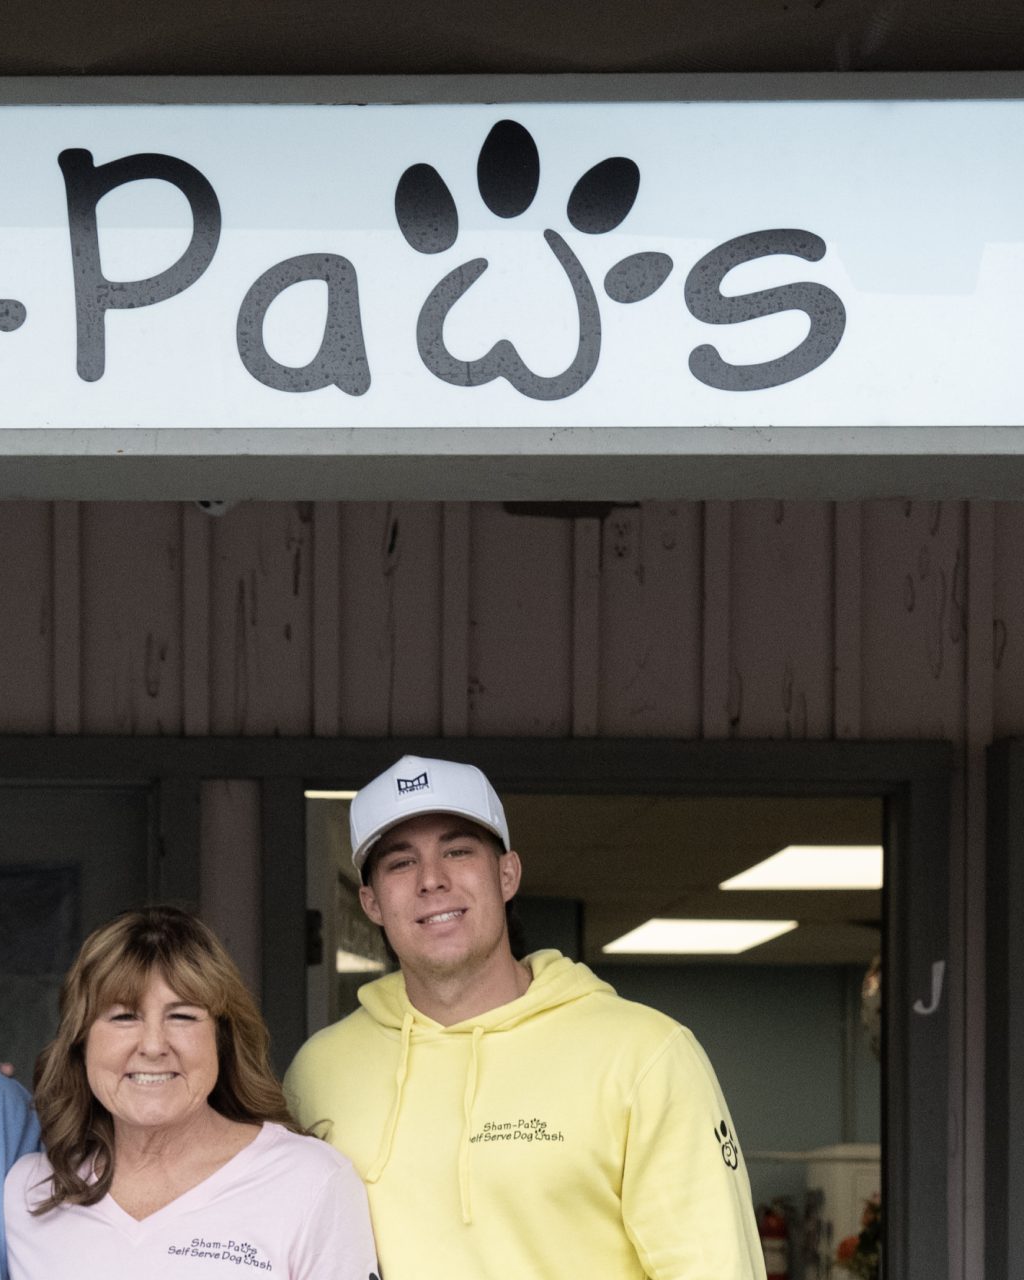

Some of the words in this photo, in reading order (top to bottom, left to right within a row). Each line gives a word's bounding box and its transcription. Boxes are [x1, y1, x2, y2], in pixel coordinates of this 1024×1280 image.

[483, 1118, 548, 1132] Sham-Paws
[484, 1132, 512, 1142] Serve
[513, 1130, 533, 1142] Dog
[535, 1128, 565, 1142] Wash
[191, 1238, 258, 1255] Sham-Paws
[167, 1245, 190, 1256] Self
[190, 1248, 221, 1260] Serve
[221, 1251, 242, 1264] Dog
[243, 1253, 273, 1271] Wash
